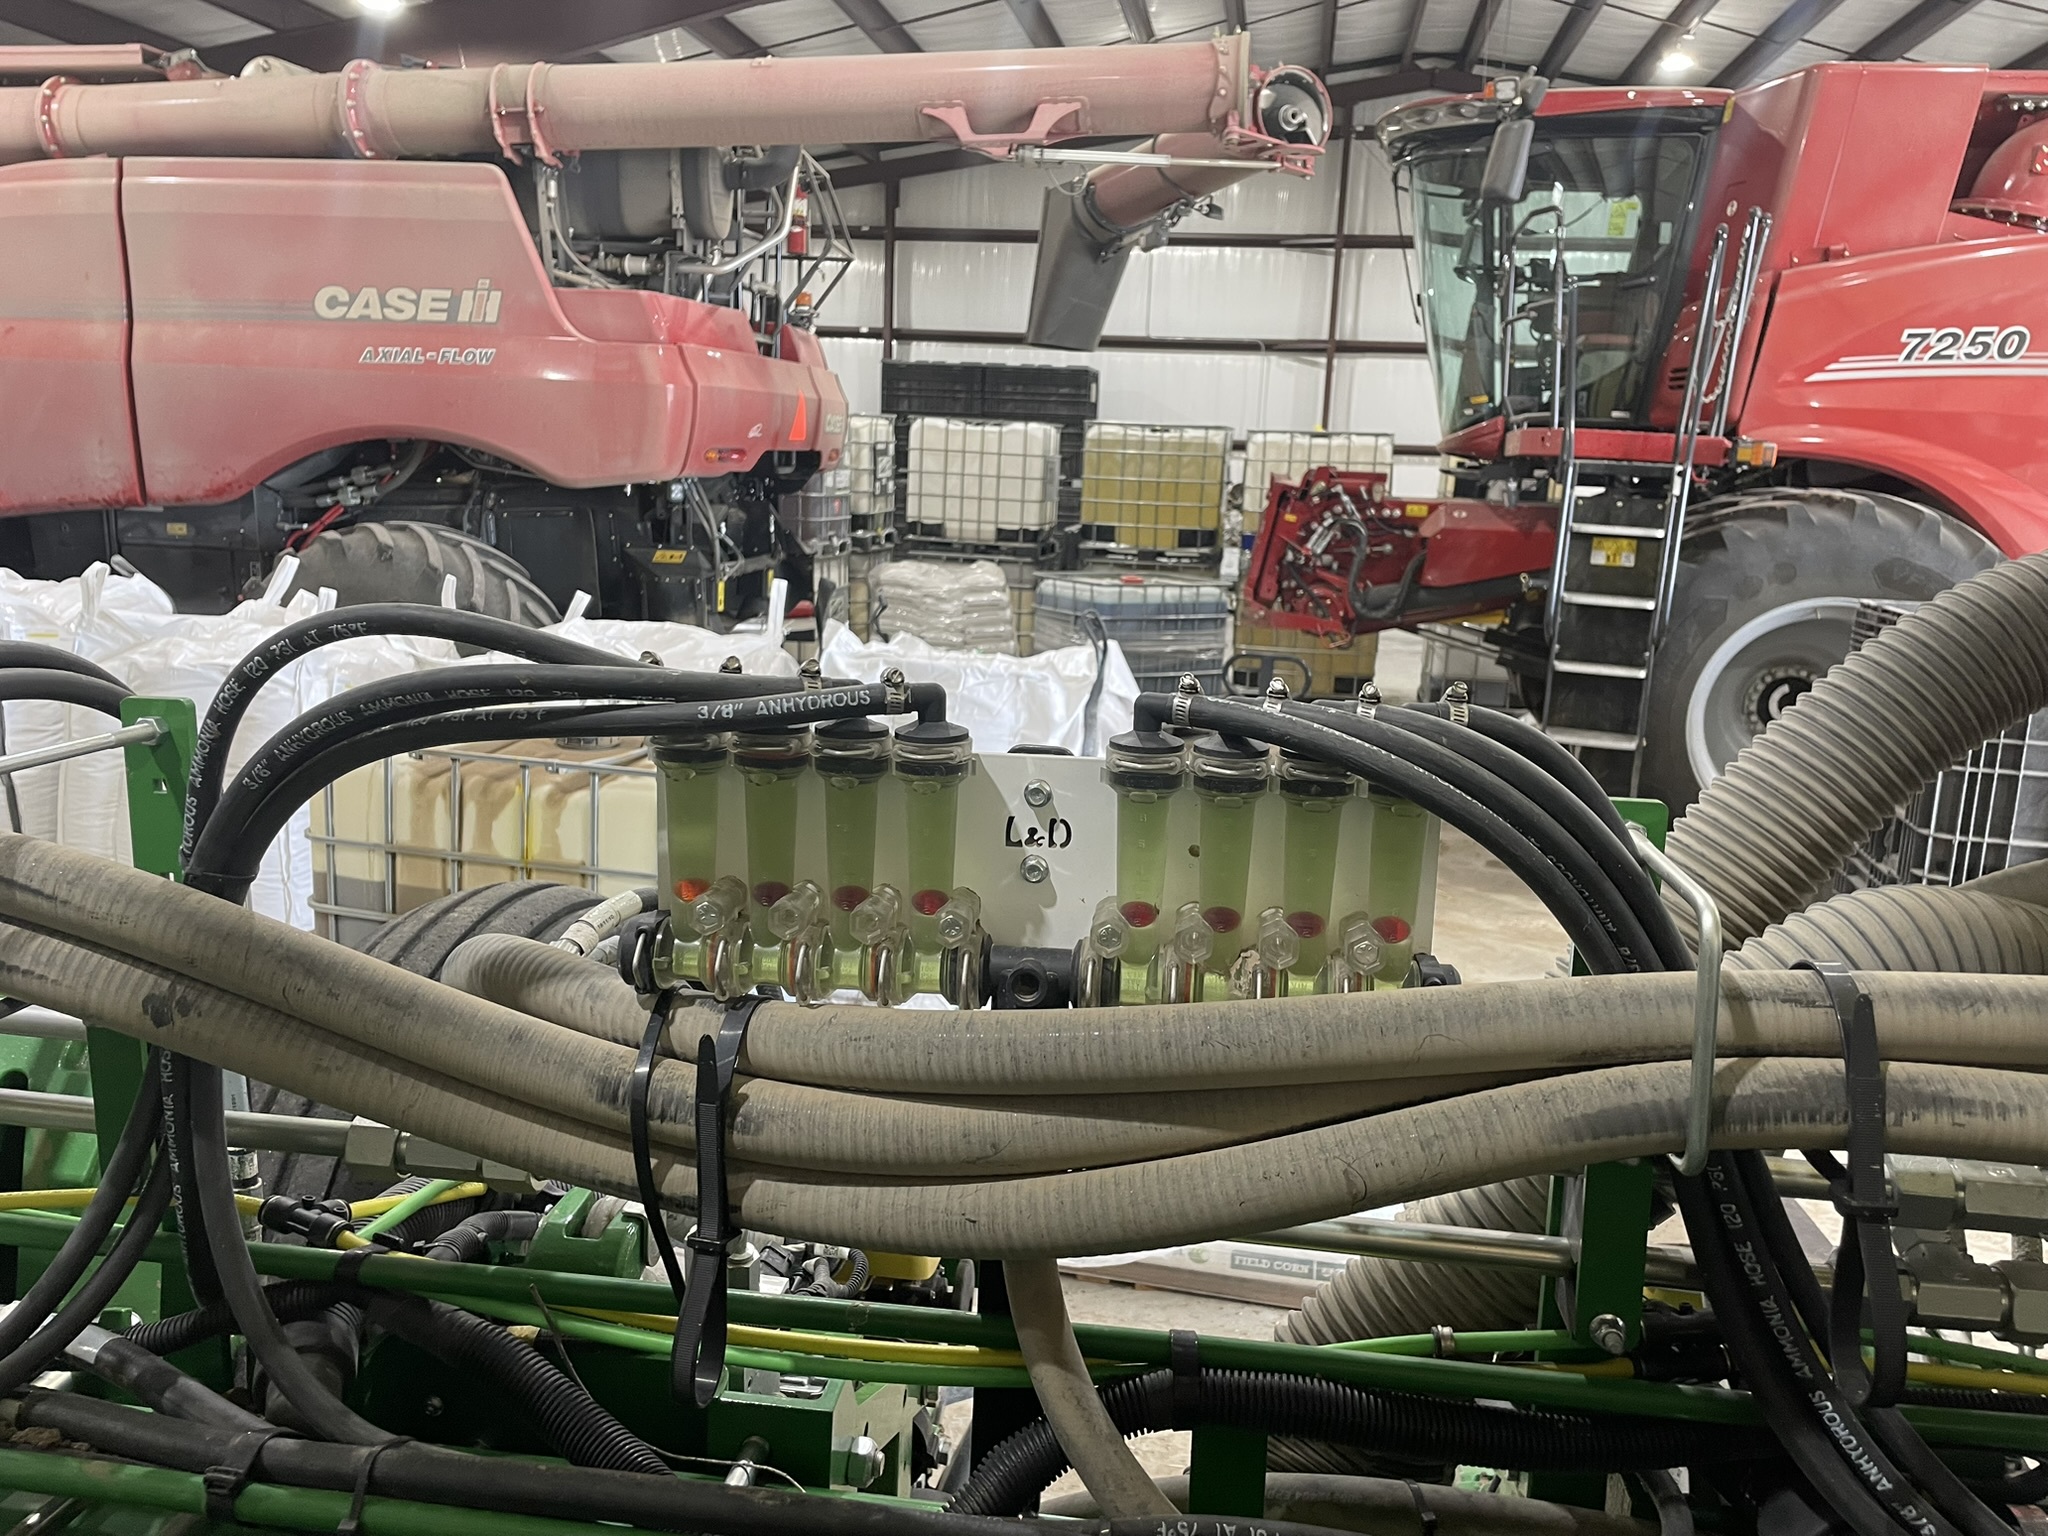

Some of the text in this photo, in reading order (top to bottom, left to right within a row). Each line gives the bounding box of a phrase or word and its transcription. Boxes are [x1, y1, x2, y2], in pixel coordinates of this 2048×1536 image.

[314, 285, 452, 322] CASE
[1898, 325, 2031, 363] 7250
[190, 718, 222, 788] AMMONIA
[213, 677, 247, 715] HOSE
[242, 655, 269, 679] 120
[304, 629, 323, 647] AT
[697, 702, 744, 720] 3/8"
[755, 689, 871, 716] ANHYDROUS
[273, 710, 354, 762] ANHYDROUS
[359, 690, 435, 716] AMMONIA
[1005, 816, 1072, 849] L&D
[160, 1050, 173, 1082] HOS
[162, 1093, 180, 1173] AMMONIA
[1719, 1203, 1744, 1230] 120
[1233, 1254, 1271, 1269] FIELD
[1272, 1261, 1311, 1274] CORN
[1734, 1241, 1767, 1287] HOSE
[1758, 1295, 1814, 1380] AMMONIA
[1808, 1390, 1894, 1492] ANHYDROUS
